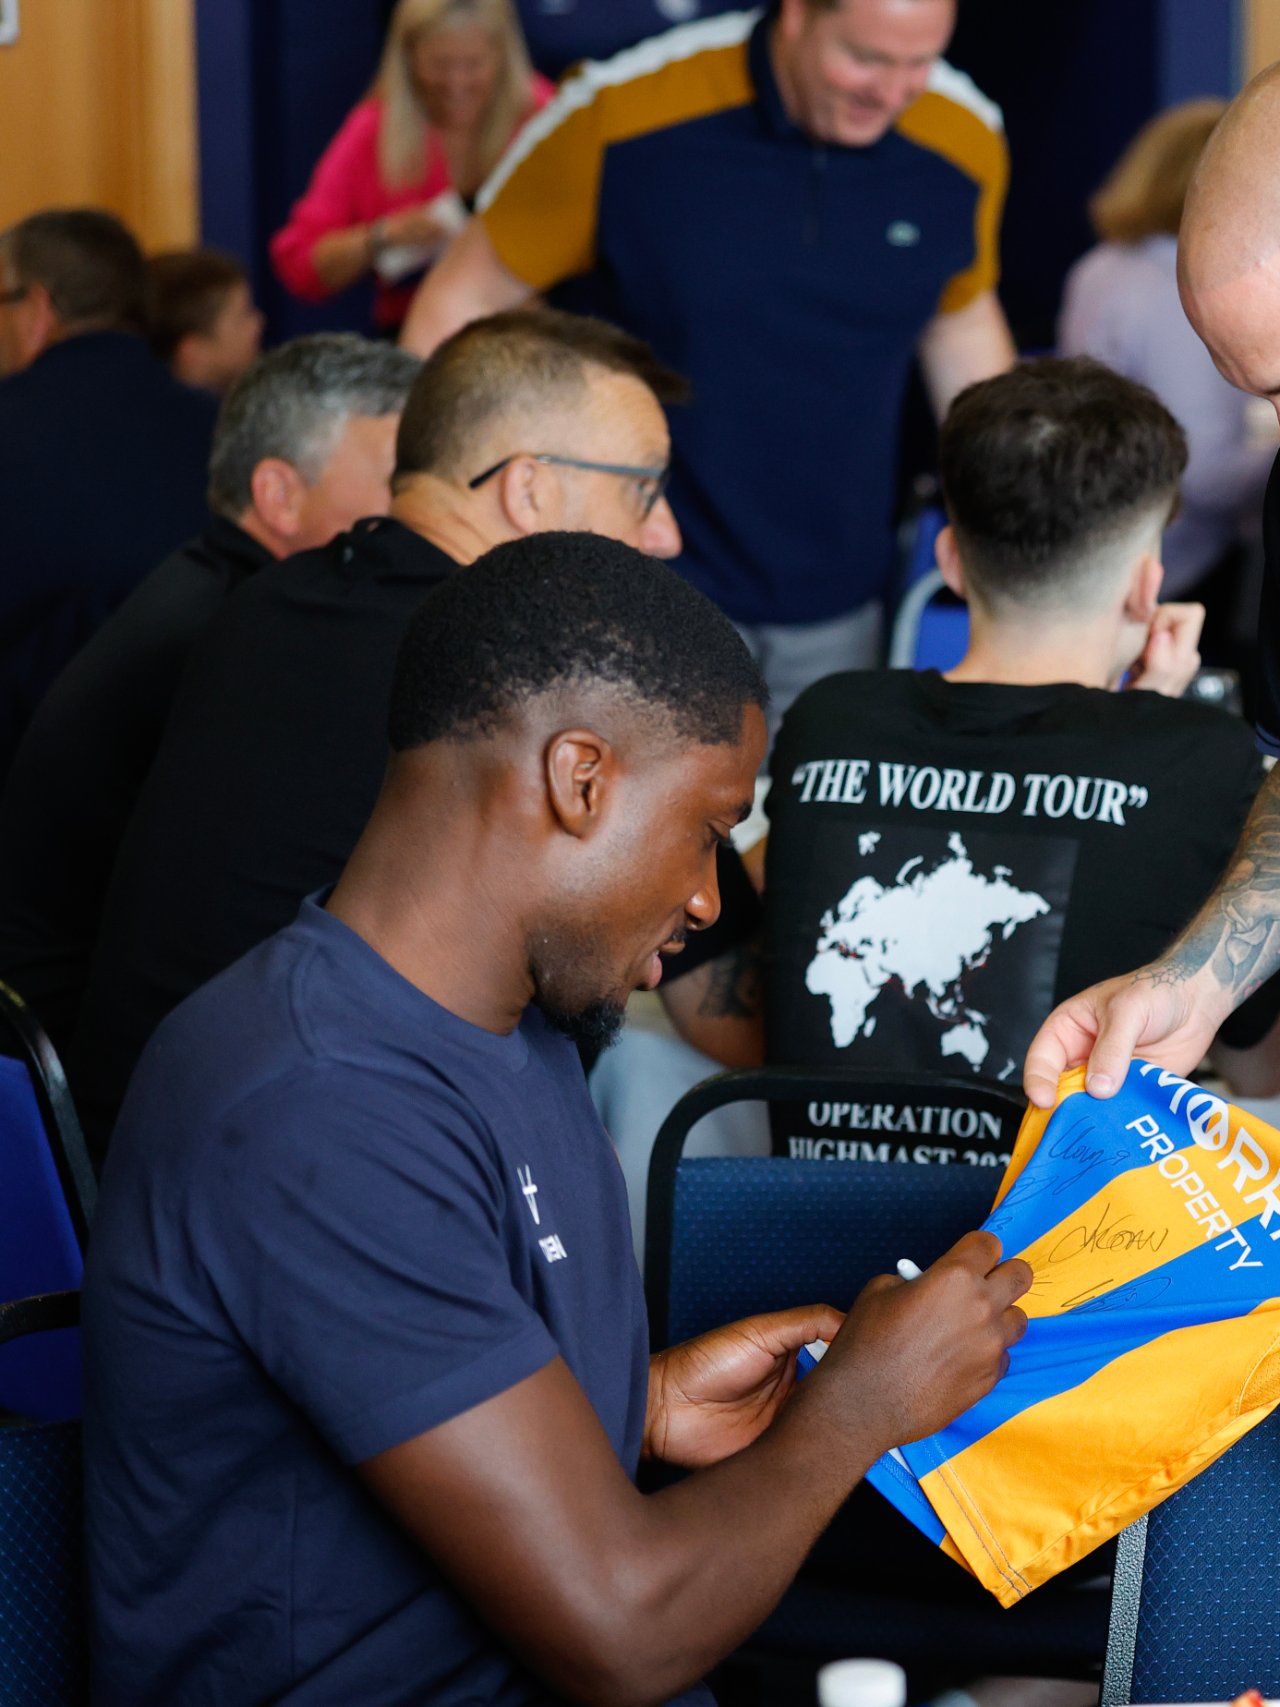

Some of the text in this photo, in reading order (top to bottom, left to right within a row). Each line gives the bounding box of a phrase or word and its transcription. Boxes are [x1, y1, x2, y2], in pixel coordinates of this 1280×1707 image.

[878, 761, 1016, 815] WORLD
[807, 1101, 1002, 1141] OPERATION
[1125, 1114, 1265, 1272] PROPERTY
